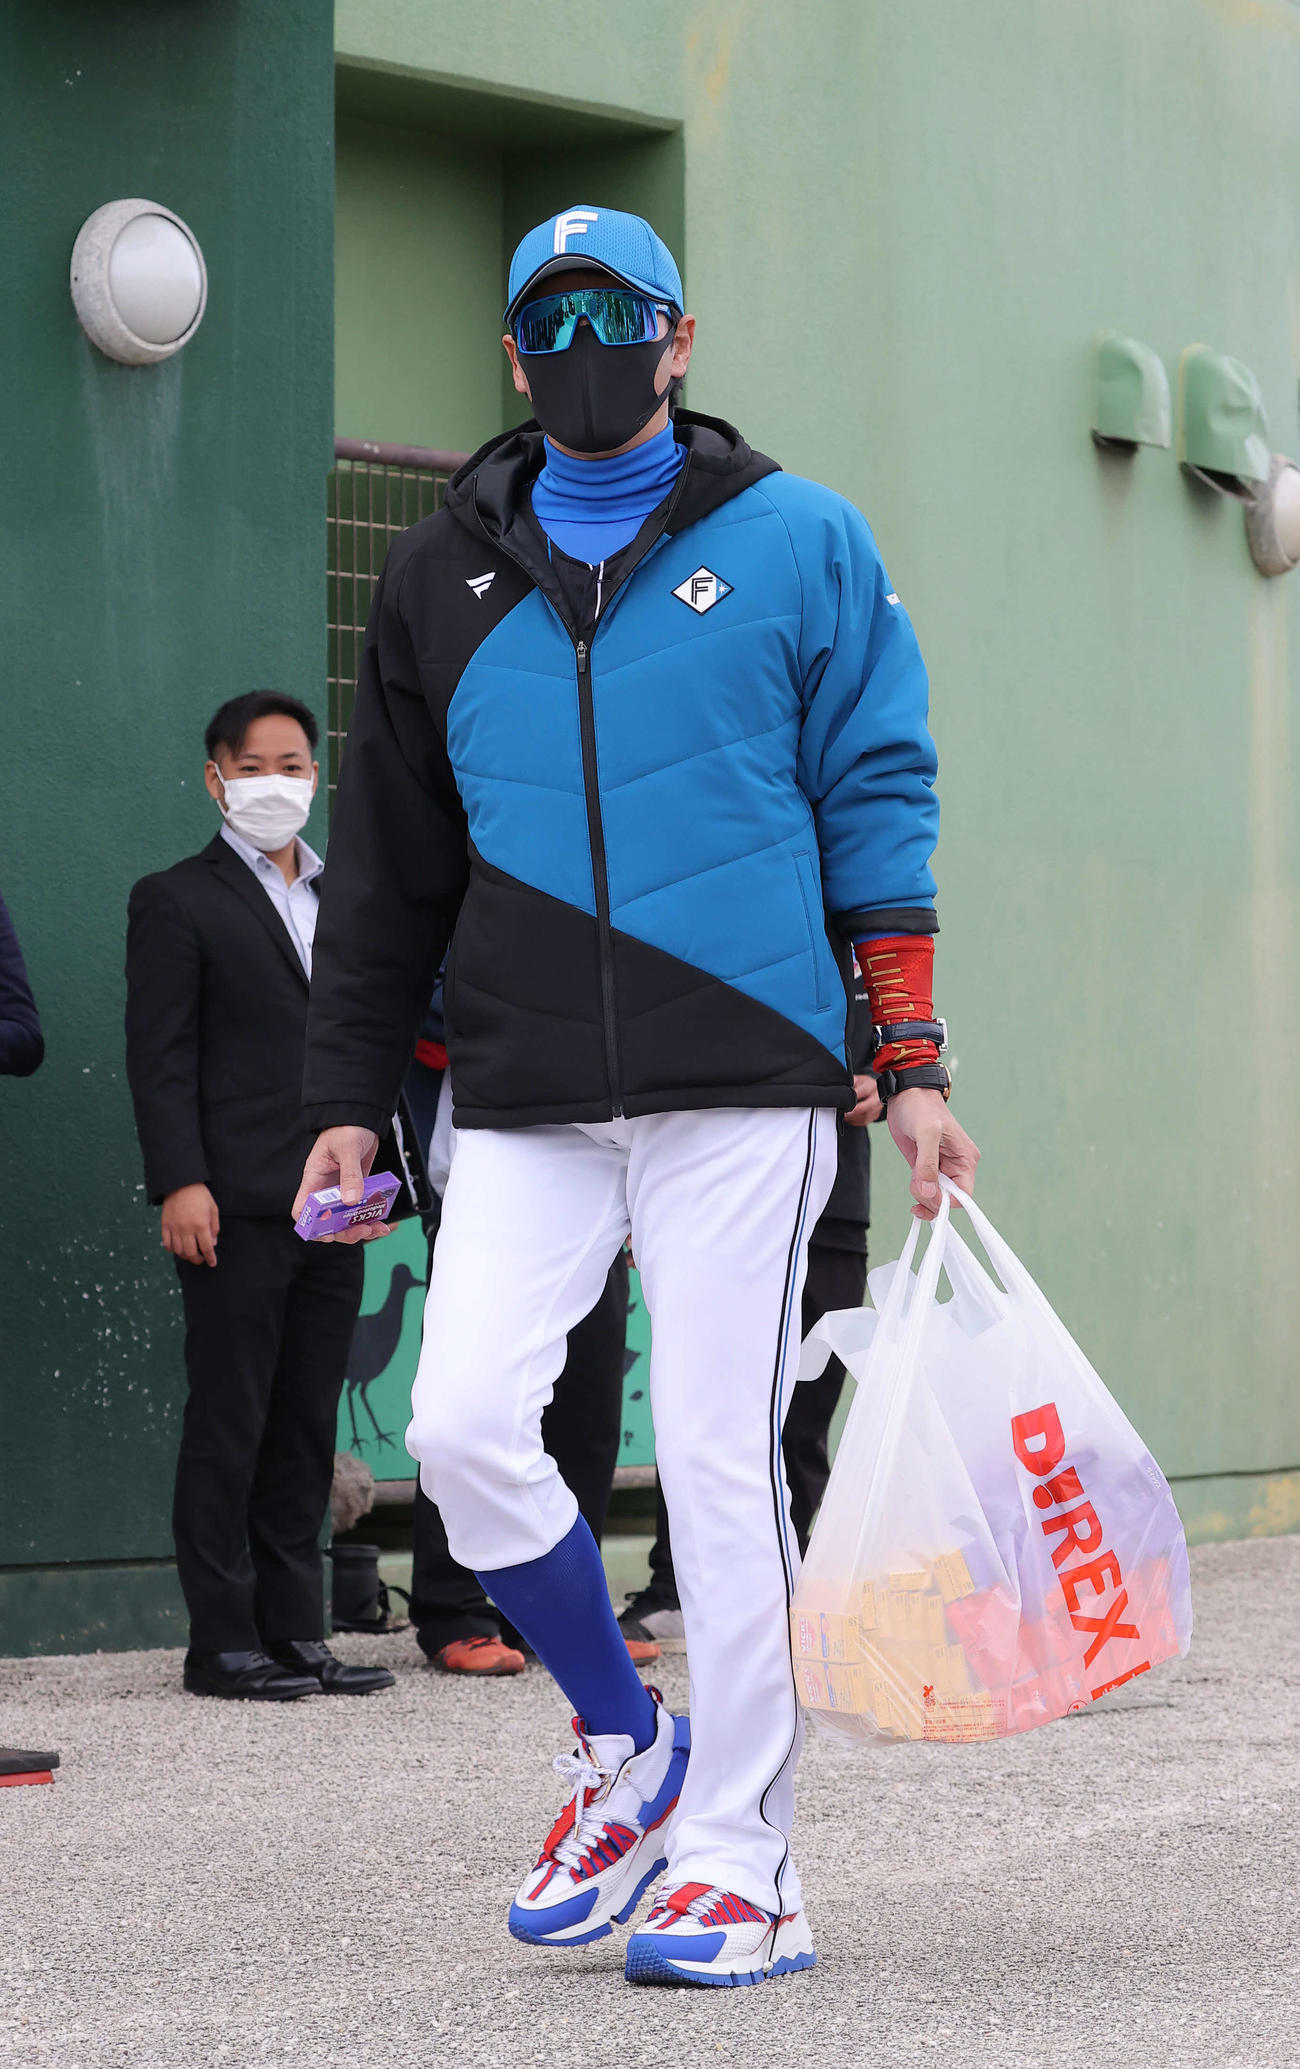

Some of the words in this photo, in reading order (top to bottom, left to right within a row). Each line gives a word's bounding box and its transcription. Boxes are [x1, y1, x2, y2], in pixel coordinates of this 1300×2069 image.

[553, 211, 598, 254] F
[691, 576, 713, 605] F
[351, 1208, 383, 1224] VICKS
